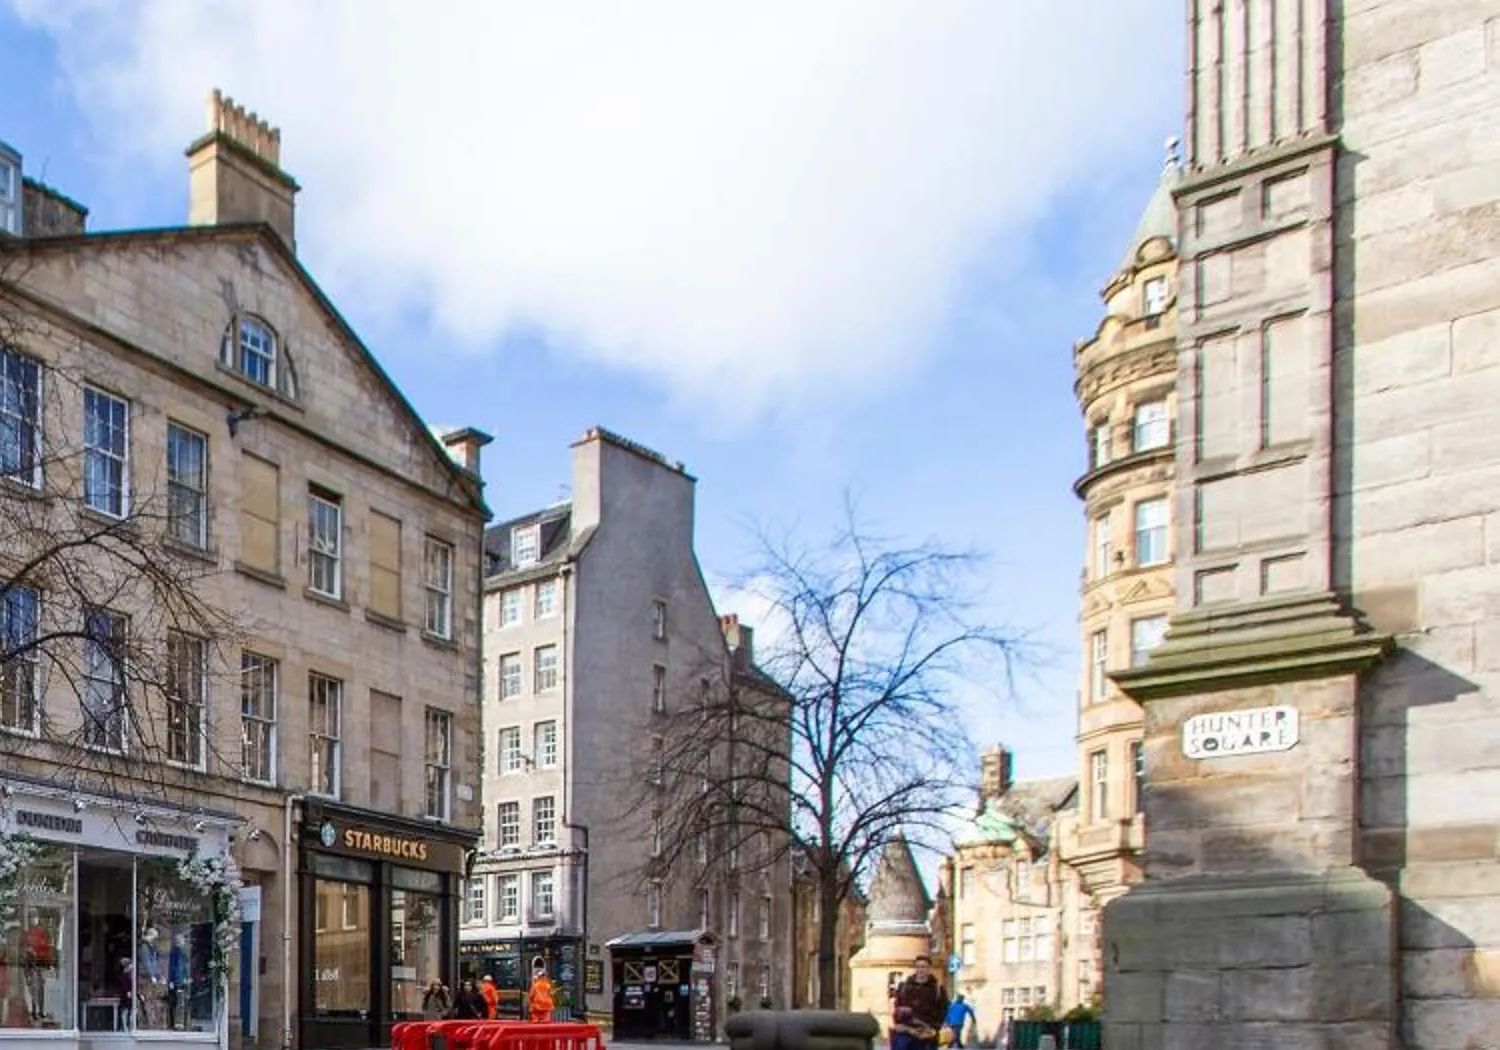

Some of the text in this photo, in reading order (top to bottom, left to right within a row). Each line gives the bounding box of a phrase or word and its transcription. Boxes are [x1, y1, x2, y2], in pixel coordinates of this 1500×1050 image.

[1190, 711, 1288, 735] HUNTER
[1189, 729, 1287, 754] SQUARE
[345, 829, 428, 860] STARBUCKS
